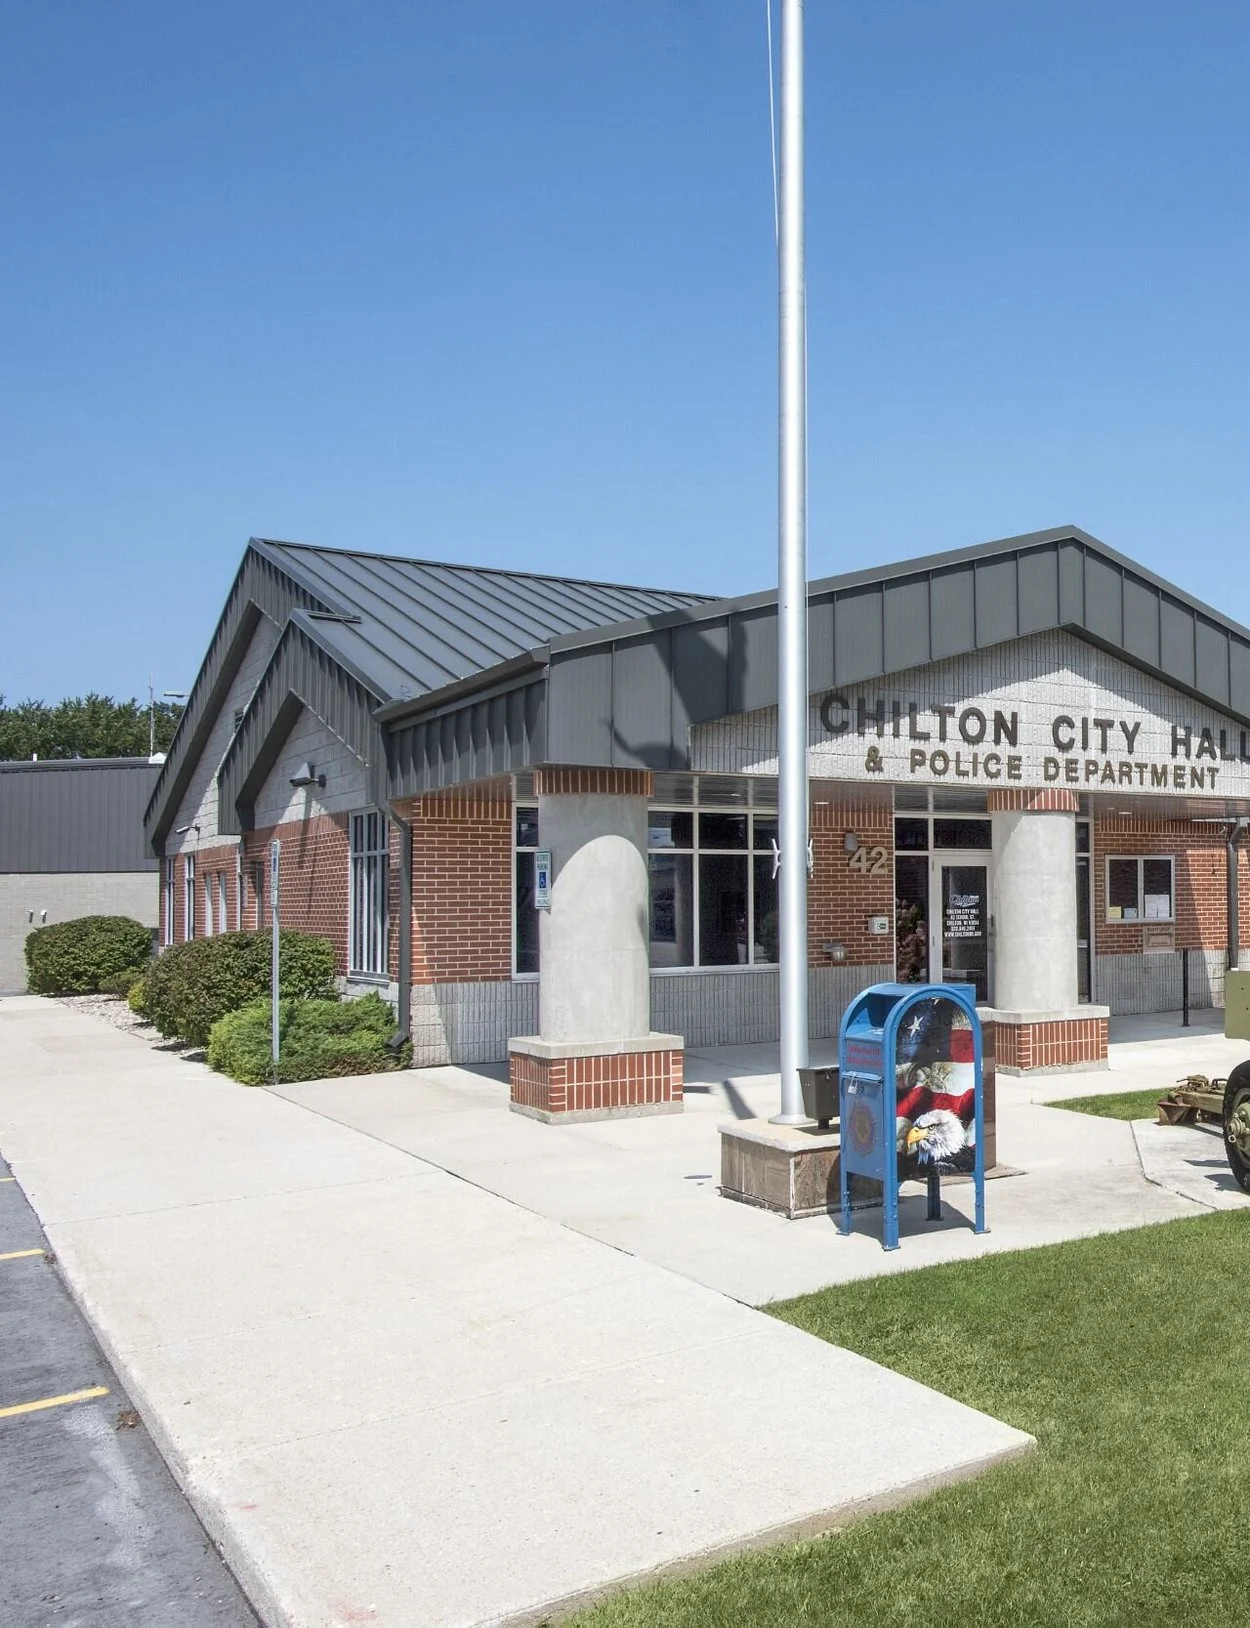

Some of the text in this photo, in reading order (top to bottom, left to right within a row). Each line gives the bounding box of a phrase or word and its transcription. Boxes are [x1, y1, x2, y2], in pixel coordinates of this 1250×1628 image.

[819, 695, 1019, 745] CHILTON
[1051, 715, 1142, 754] CITY
[864, 745, 1220, 789] & POLICE DEPARTMENT
[850, 847, 888, 875] 42
